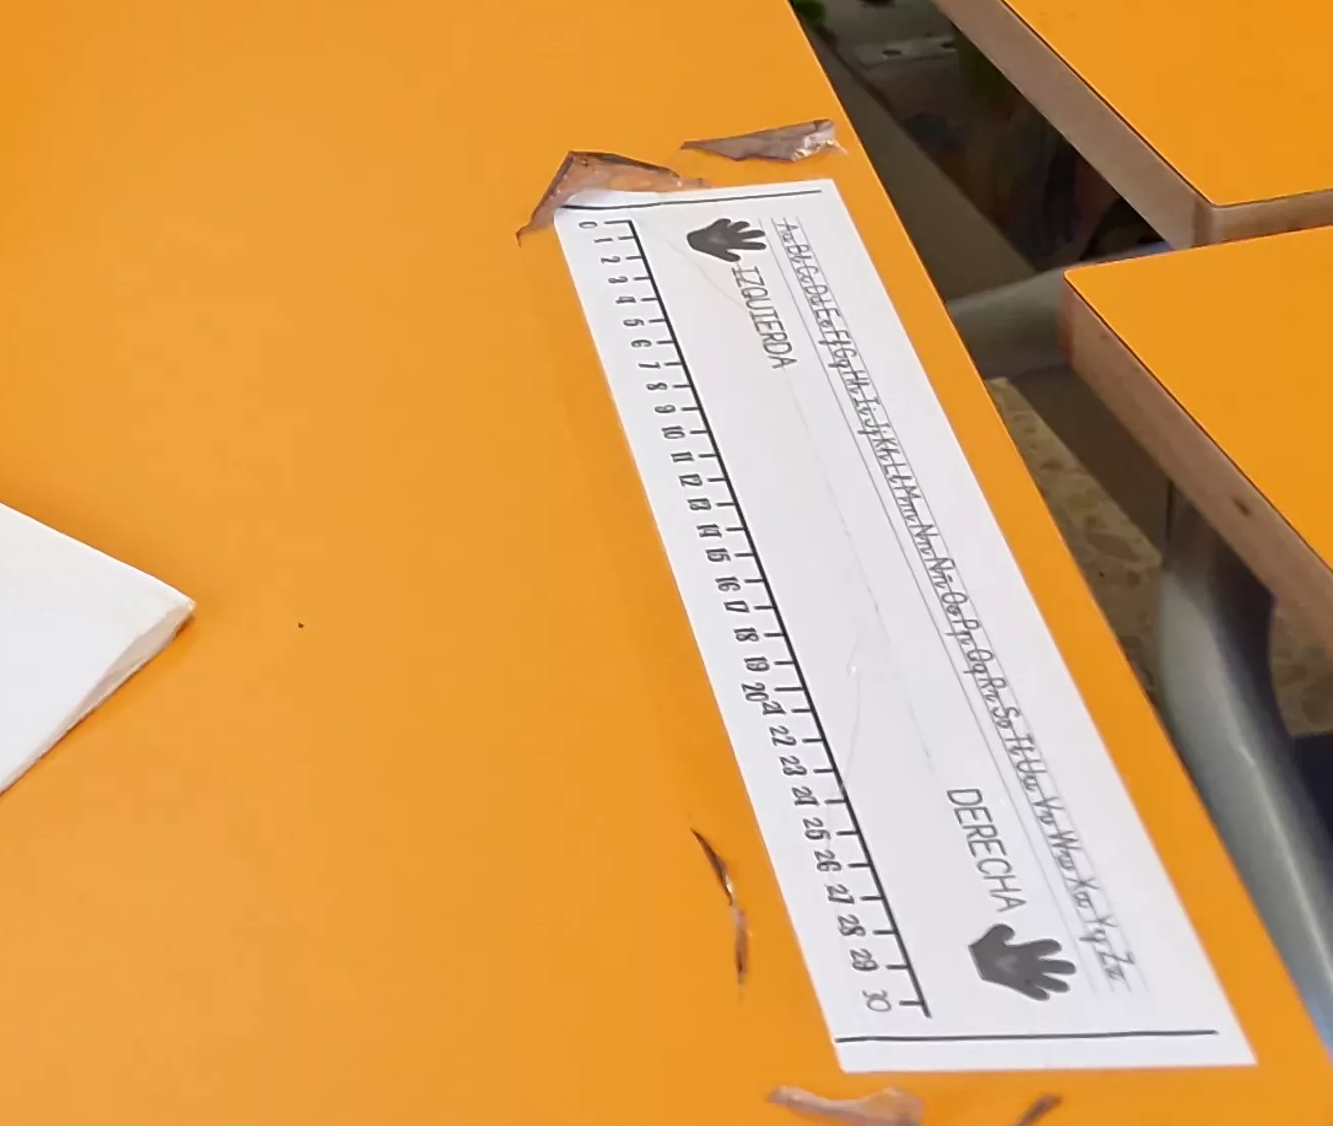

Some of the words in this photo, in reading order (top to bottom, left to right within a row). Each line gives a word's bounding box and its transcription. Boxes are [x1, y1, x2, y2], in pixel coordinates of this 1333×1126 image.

[578, 221, 598, 229] 0
[600, 256, 621, 264] 2
[608, 276, 629, 284] 3
[615, 296, 637, 305] 4
[623, 318, 645, 327] 5
[732, 265, 798, 370] IZQUIERDA
[630, 339, 652, 348] 6
[638, 361, 661, 369] 7
[646, 382, 668, 391] 8
[654, 404, 676, 414] 9
[661, 425, 686, 440] 10
[670, 451, 695, 463] 11
[678, 473, 703, 487] 12
[687, 497, 712, 511] 13
[696, 523, 723, 538] 14
[705, 547, 731, 563] 15
[714, 576, 741, 592] 16
[723, 600, 750, 614] 17
[733, 627, 760, 642] 18
[743, 656, 770, 672] 19
[740, 682, 770, 703] 20
[760, 699, 787, 717] 21
[769, 725, 797, 747] 22
[779, 755, 808, 776] 23
[791, 786, 820, 806] 24
[802, 817, 831, 841] 25
[946, 787, 1028, 914] DERECHA
[814, 849, 842, 872] 26
[826, 884, 855, 905] 27
[837, 914, 866, 937] 28
[849, 948, 879, 972] 29
[862, 990, 892, 1012] 30
